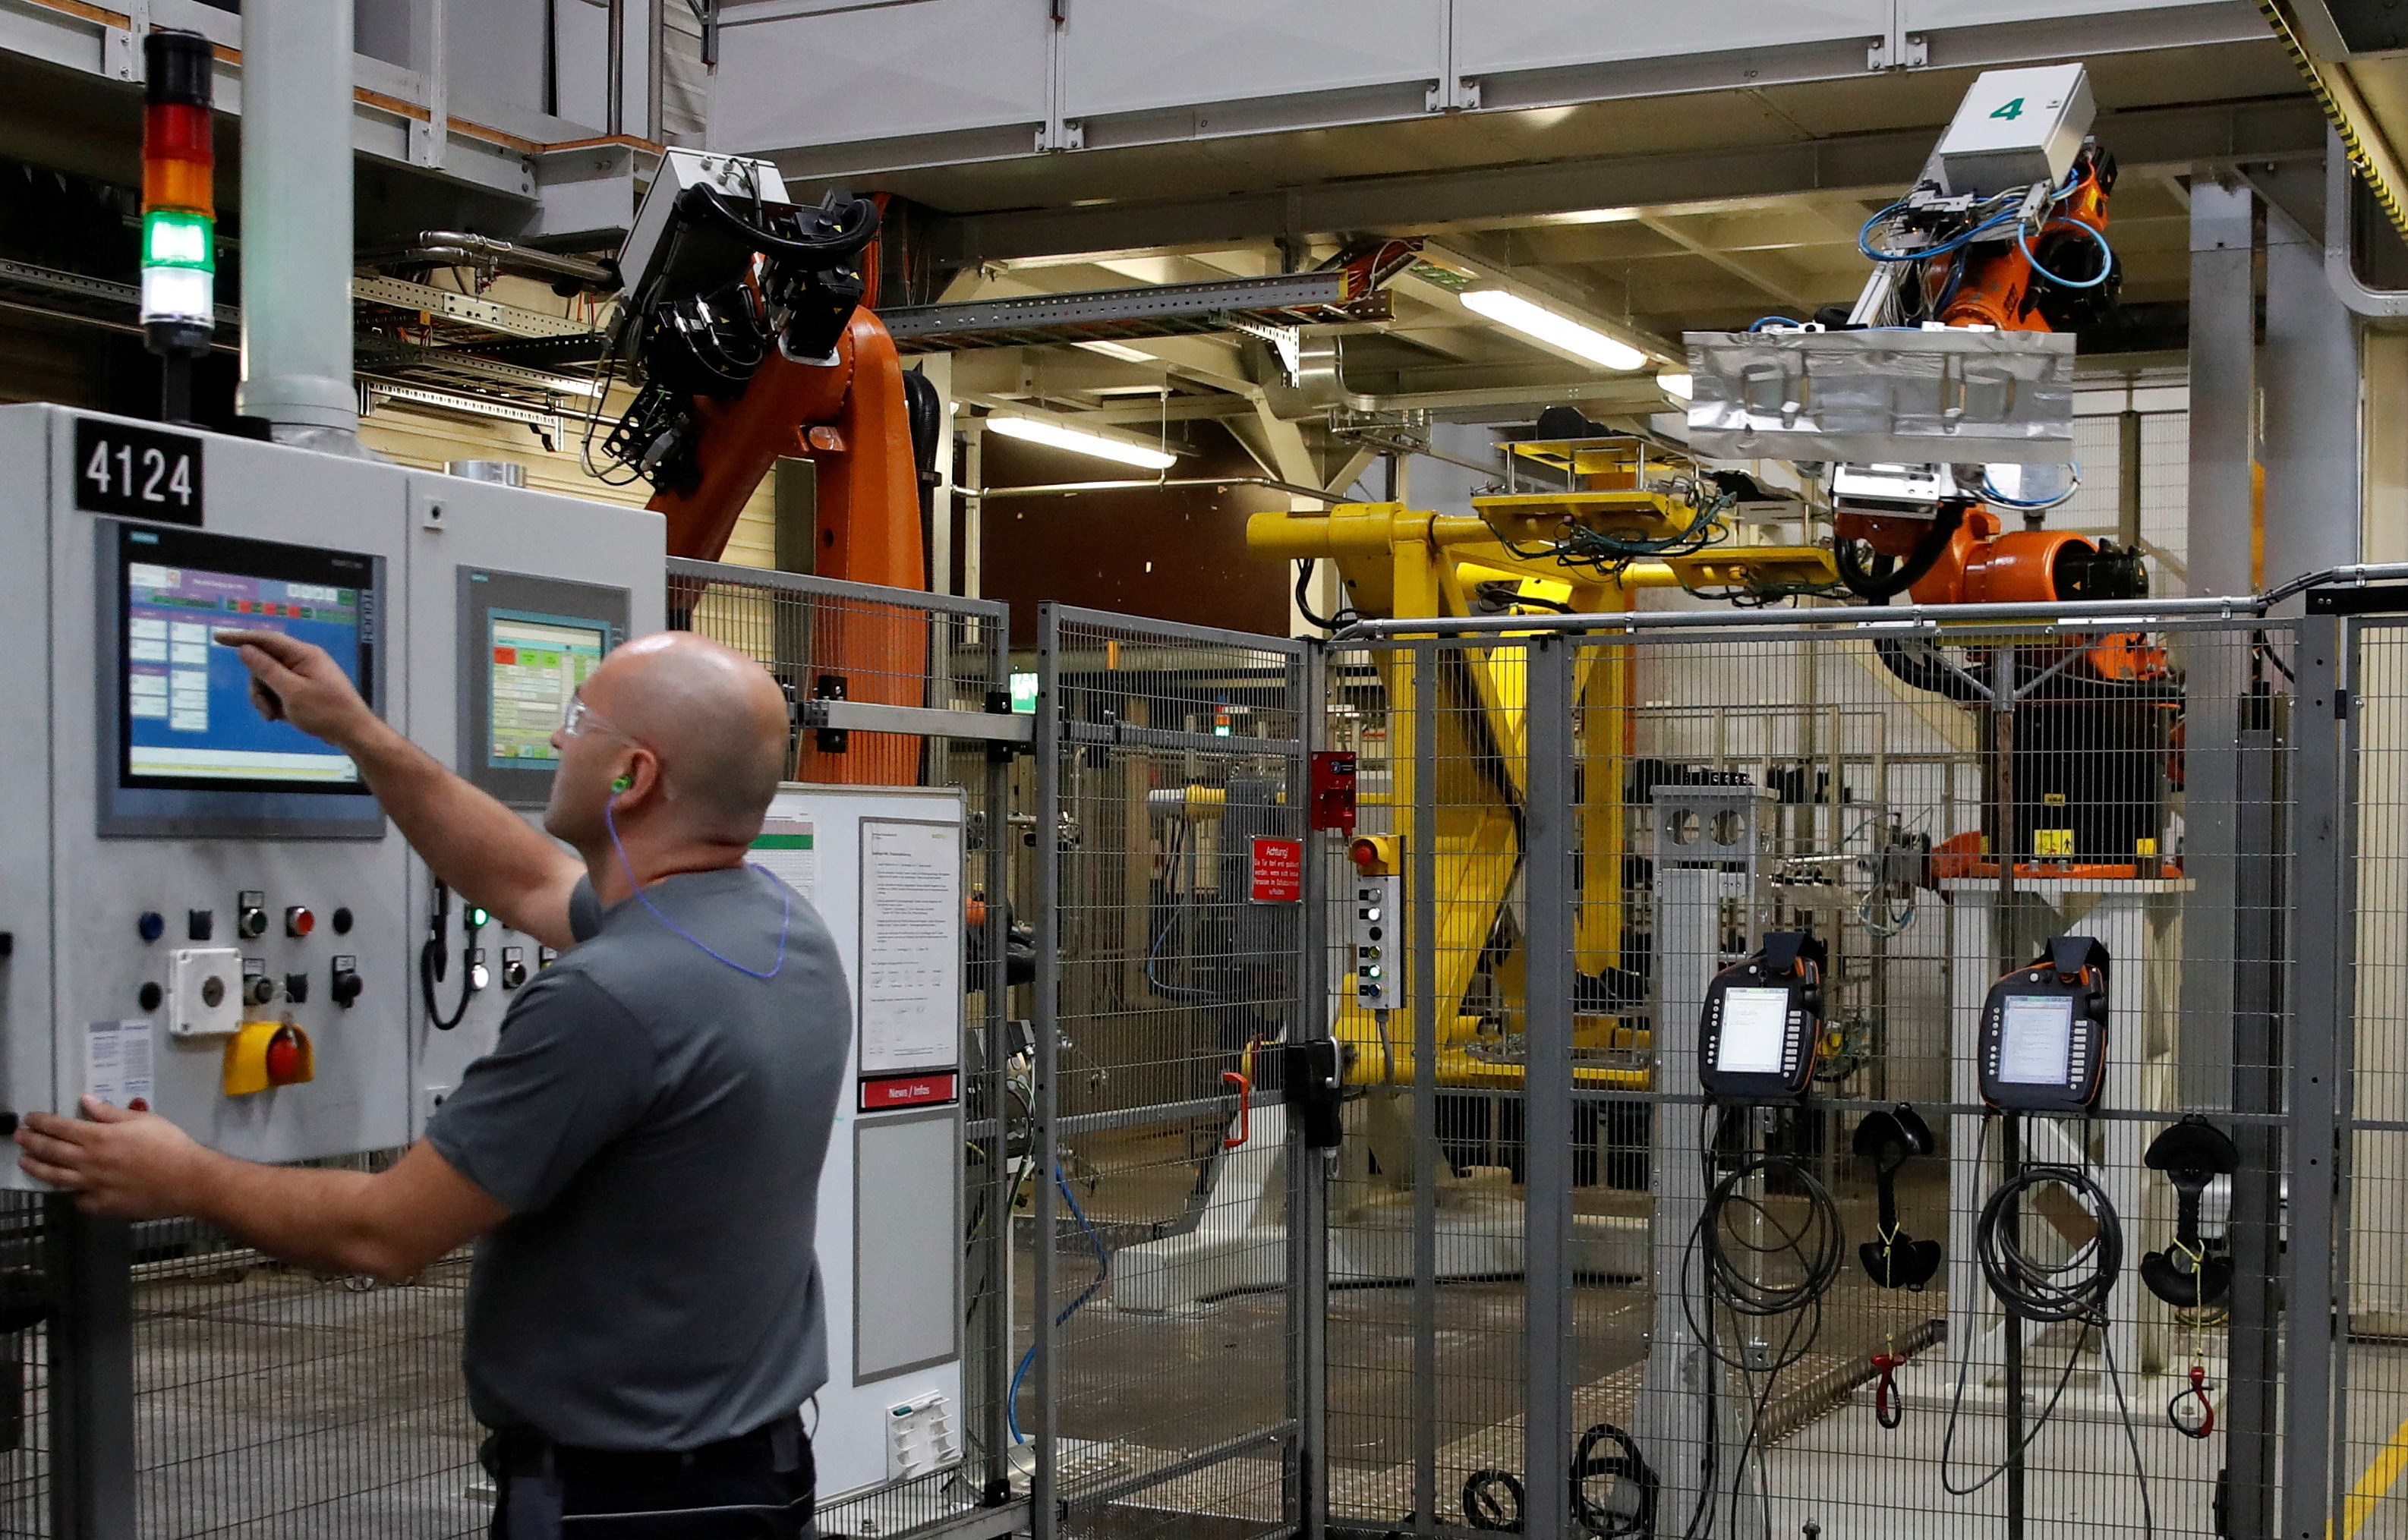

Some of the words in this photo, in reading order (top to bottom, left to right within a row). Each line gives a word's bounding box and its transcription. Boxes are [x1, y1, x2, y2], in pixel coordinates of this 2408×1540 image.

[1988, 97, 2025, 120] 4
[86, 439, 192, 505] 4124
[364, 593, 373, 641] TOUCH
[1265, 846, 1288, 858] Achtung!
[889, 1088, 908, 1098] News
[913, 1085, 930, 1095] Infos
